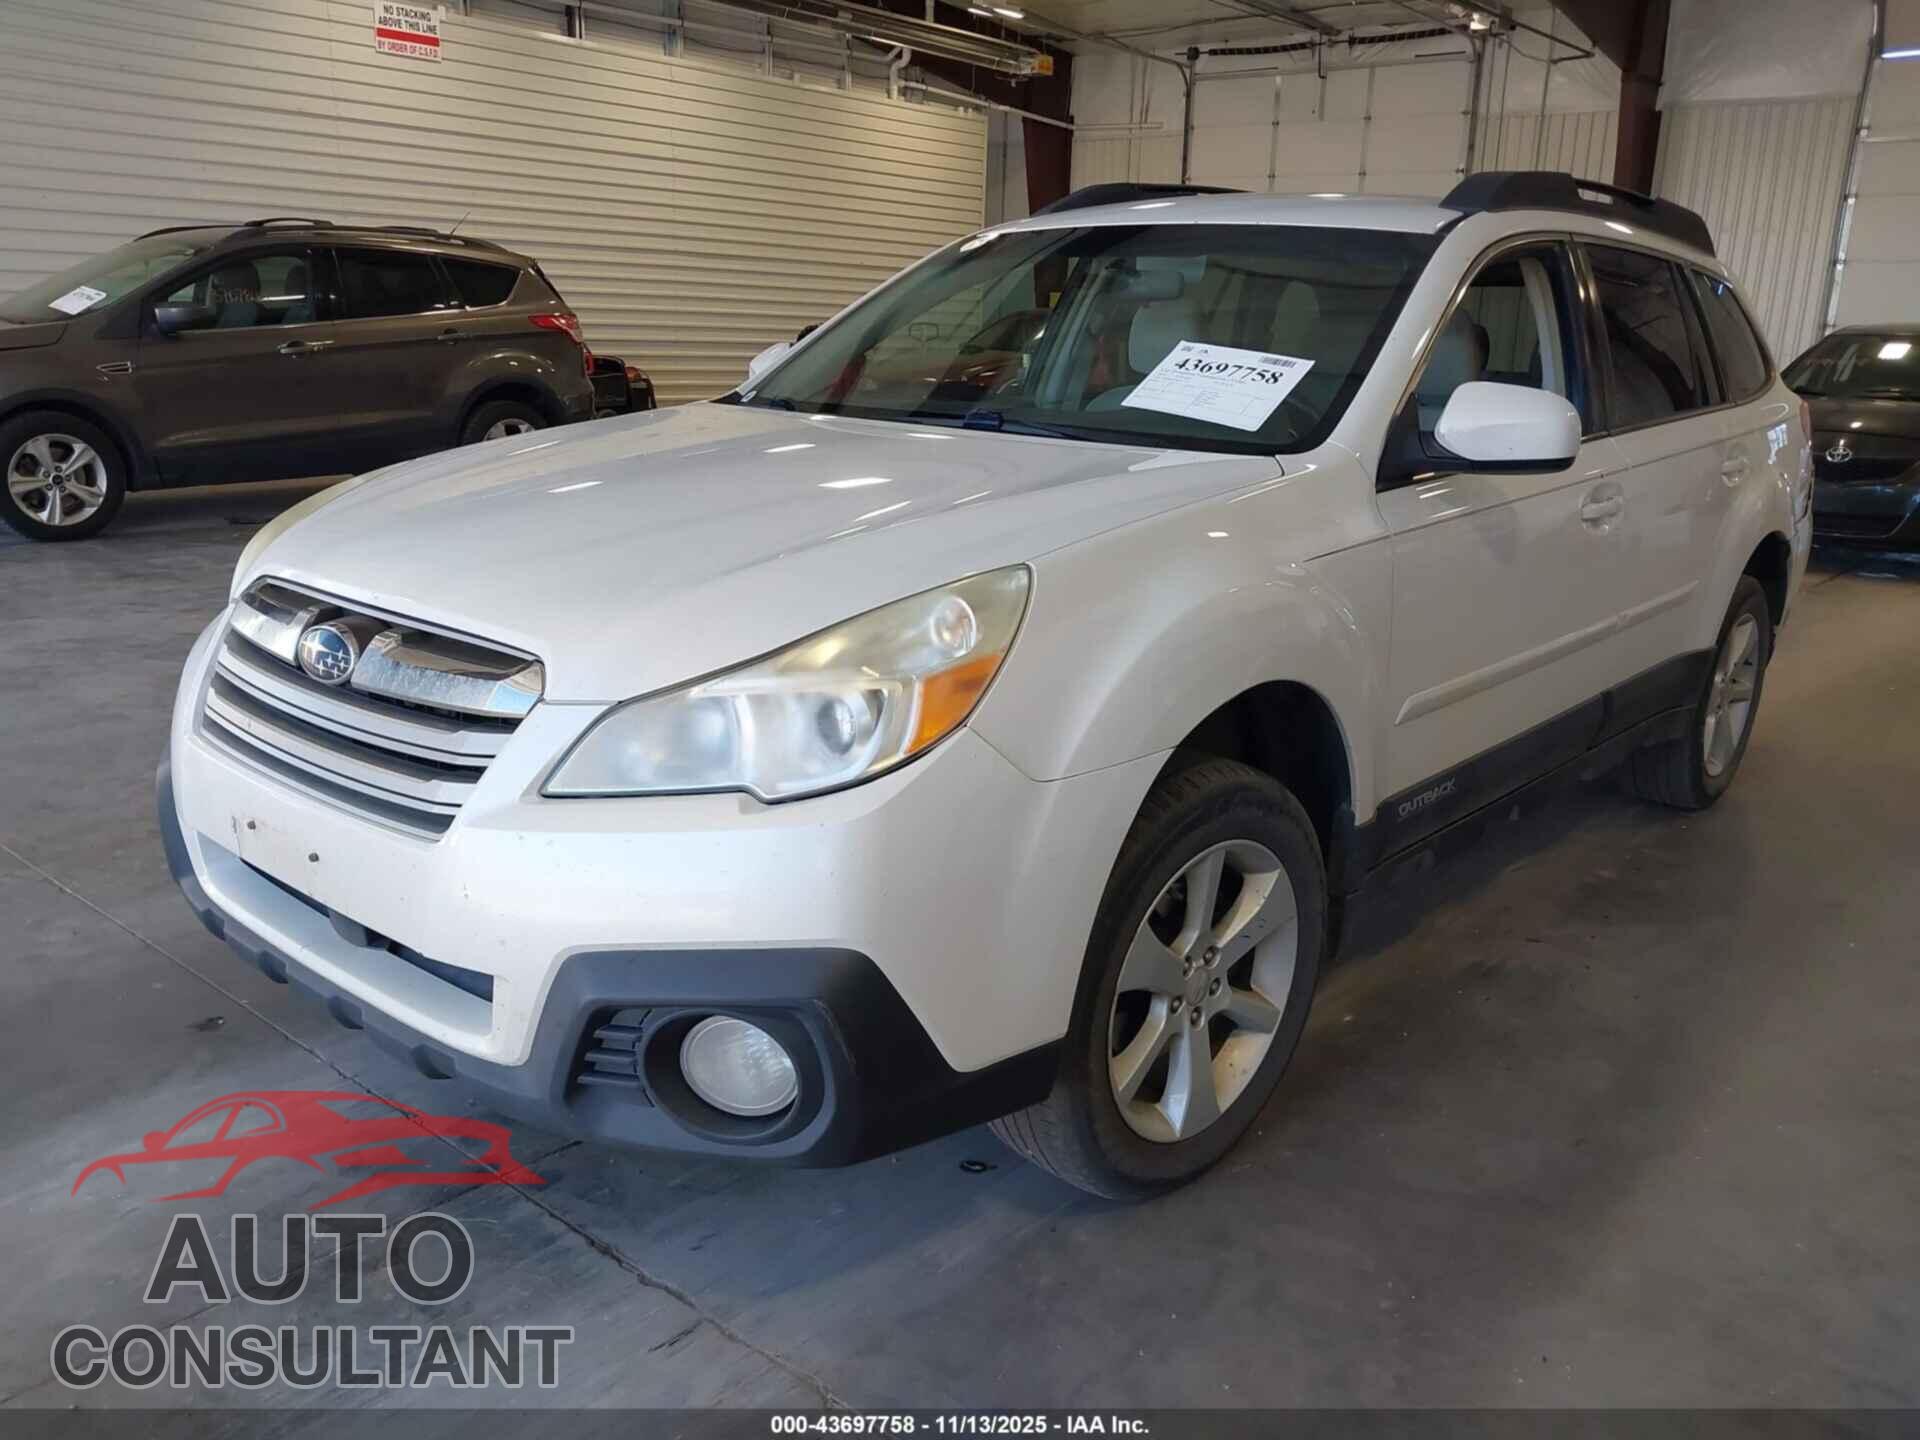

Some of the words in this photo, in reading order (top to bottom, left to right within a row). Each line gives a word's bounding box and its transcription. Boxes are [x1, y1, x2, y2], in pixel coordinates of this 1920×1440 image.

[378, 15, 402, 29] ABOVE
[404, 19, 420, 32] THIS
[421, 22, 438, 34] LINE
[383, 5, 394, 16] NO
[395, 6, 432, 22] STACKING
[1174, 357, 1283, 385] 43697758
[1398, 776, 1457, 817] OUTBACK
